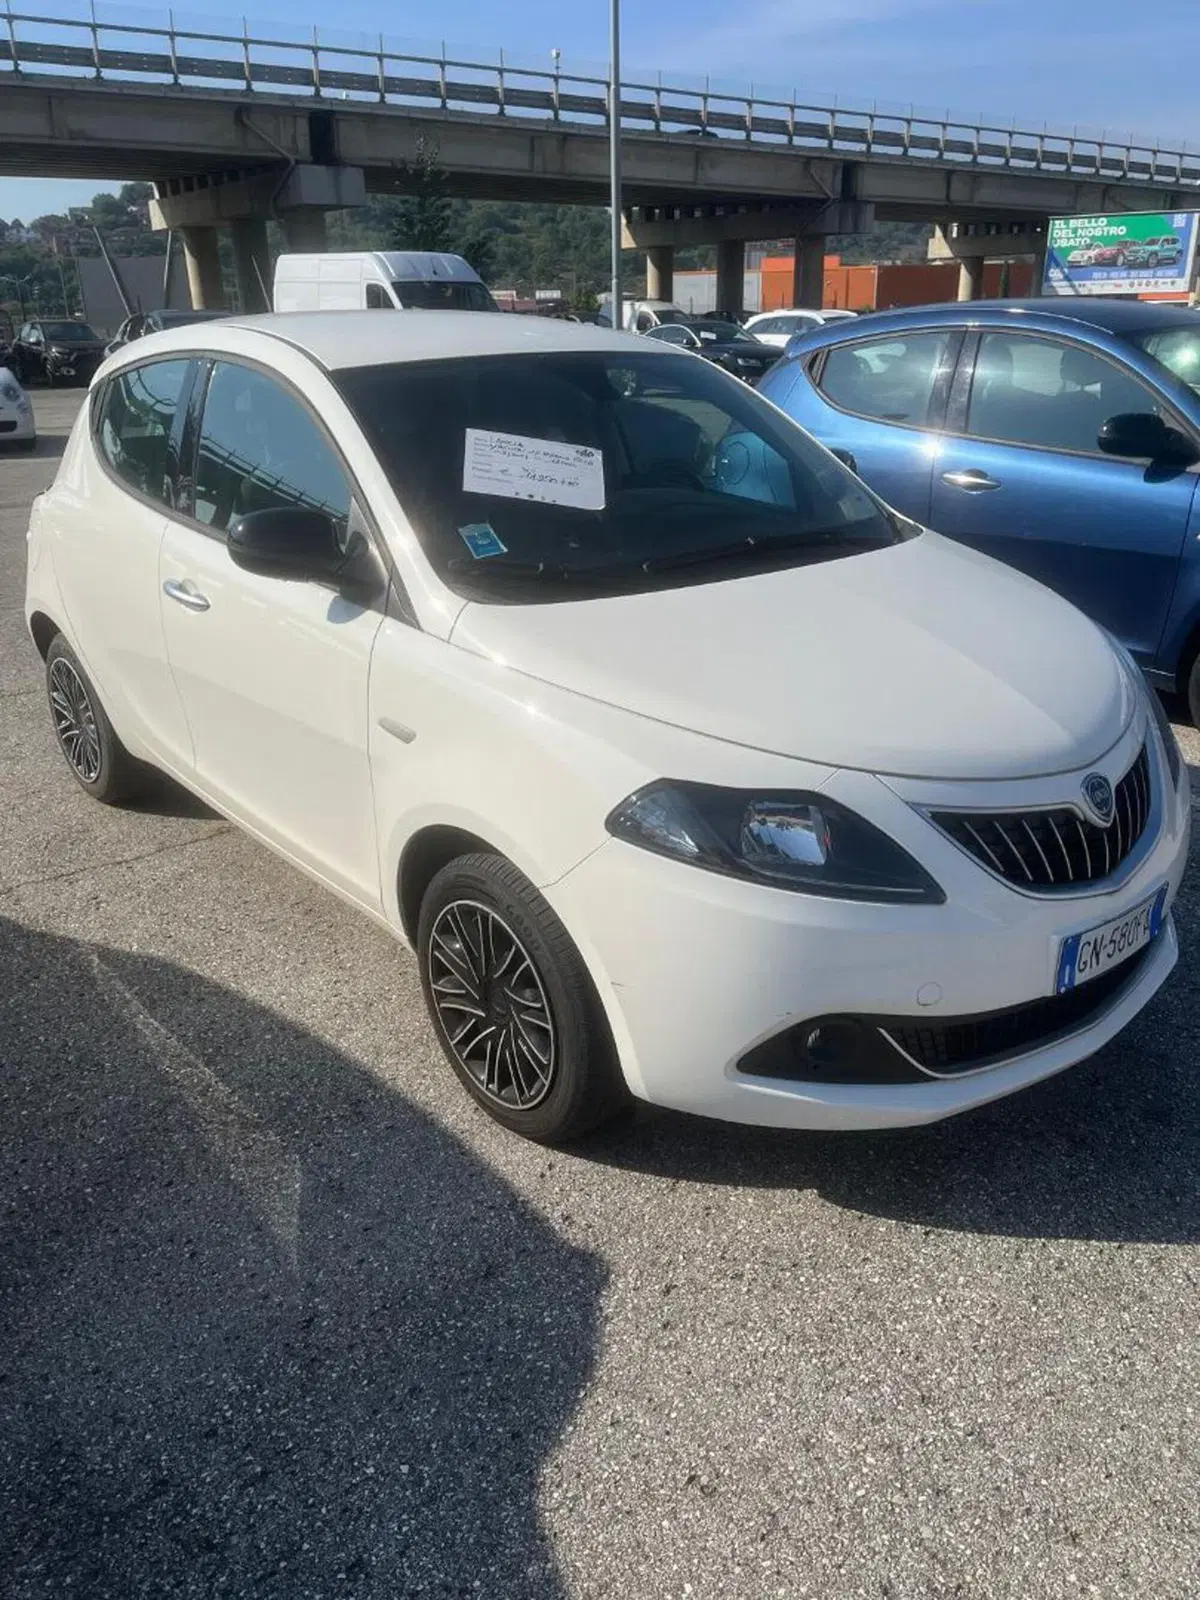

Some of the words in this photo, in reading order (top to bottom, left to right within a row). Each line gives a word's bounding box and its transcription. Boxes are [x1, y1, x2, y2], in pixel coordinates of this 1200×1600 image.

[1054, 219, 1067, 229] IL
[1069, 217, 1107, 228] BELLO
[1053, 228, 1075, 238] DEL
[1077, 225, 1127, 237] NOSTRO
